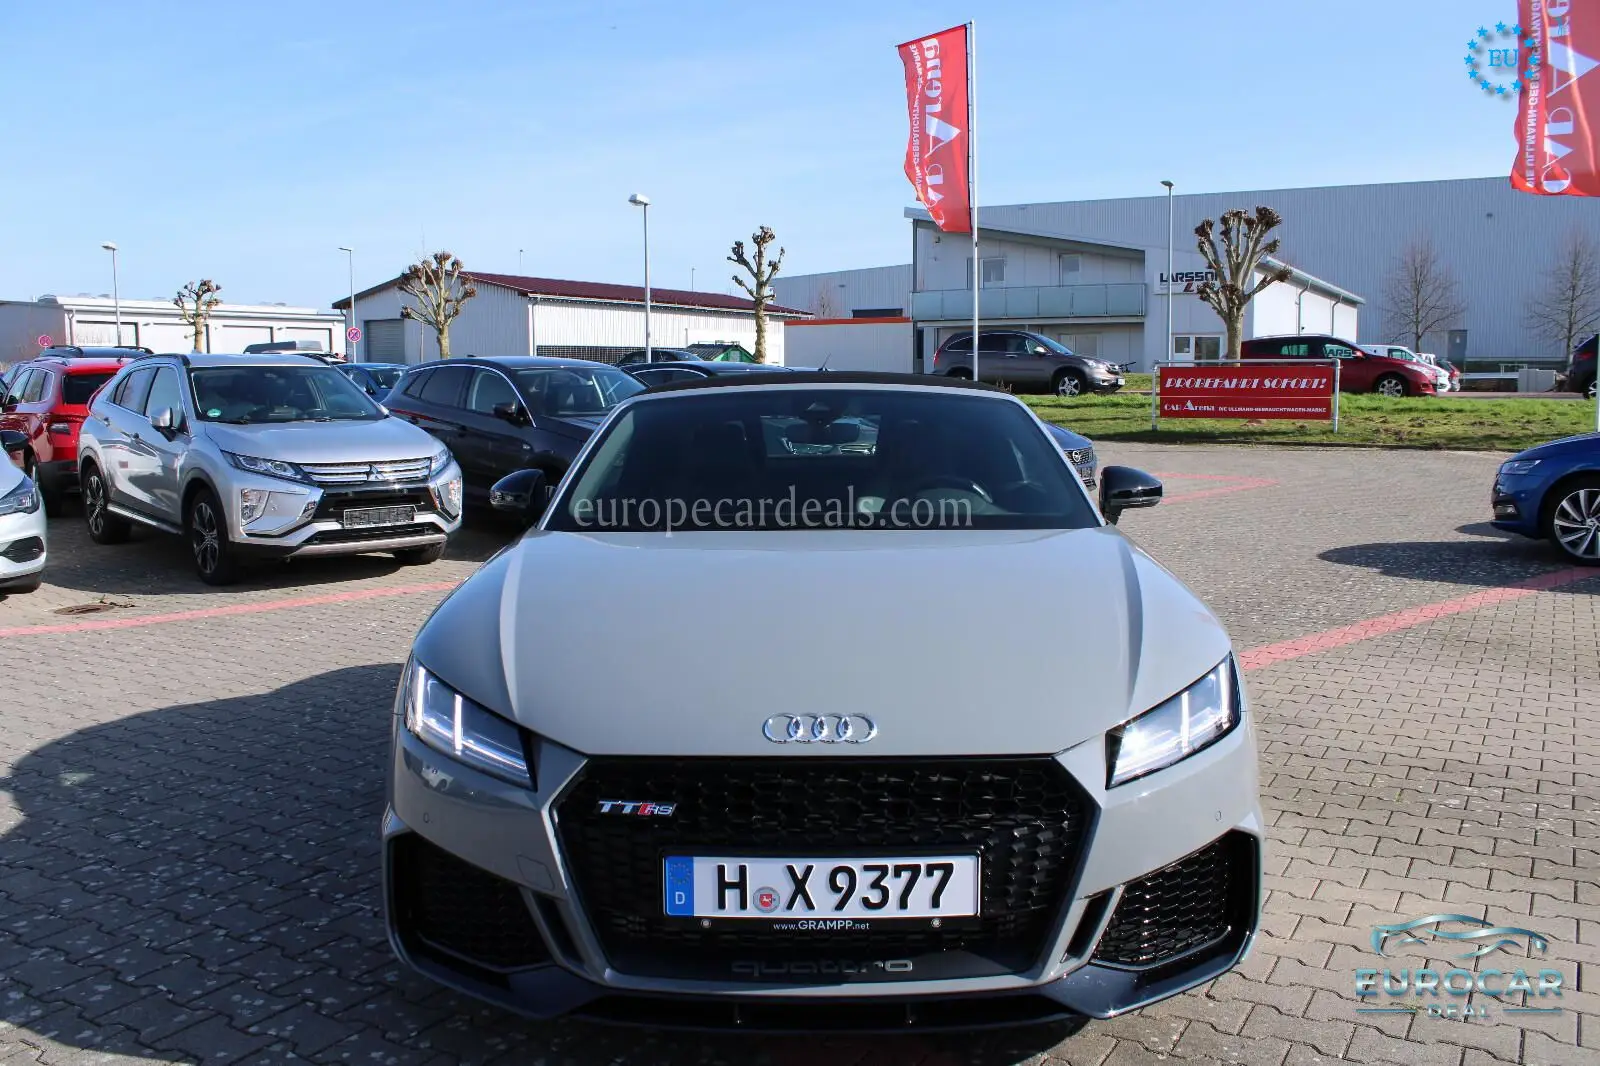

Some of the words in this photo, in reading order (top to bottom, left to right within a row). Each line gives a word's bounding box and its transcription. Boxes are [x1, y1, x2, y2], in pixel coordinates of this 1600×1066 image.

[1165, 377, 1260, 389] PROBEFAHRT
[1263, 377, 1327, 389] SOFORT!
[1183, 400, 1215, 411] Arena
[716, 864, 748, 910] H
[785, 864, 816, 911] X
[828, 863, 954, 911] 9377
[675, 892, 685, 905] D
[773, 920, 870, 930] www.GRAMPP.net
[731, 959, 913, 976] quattro
